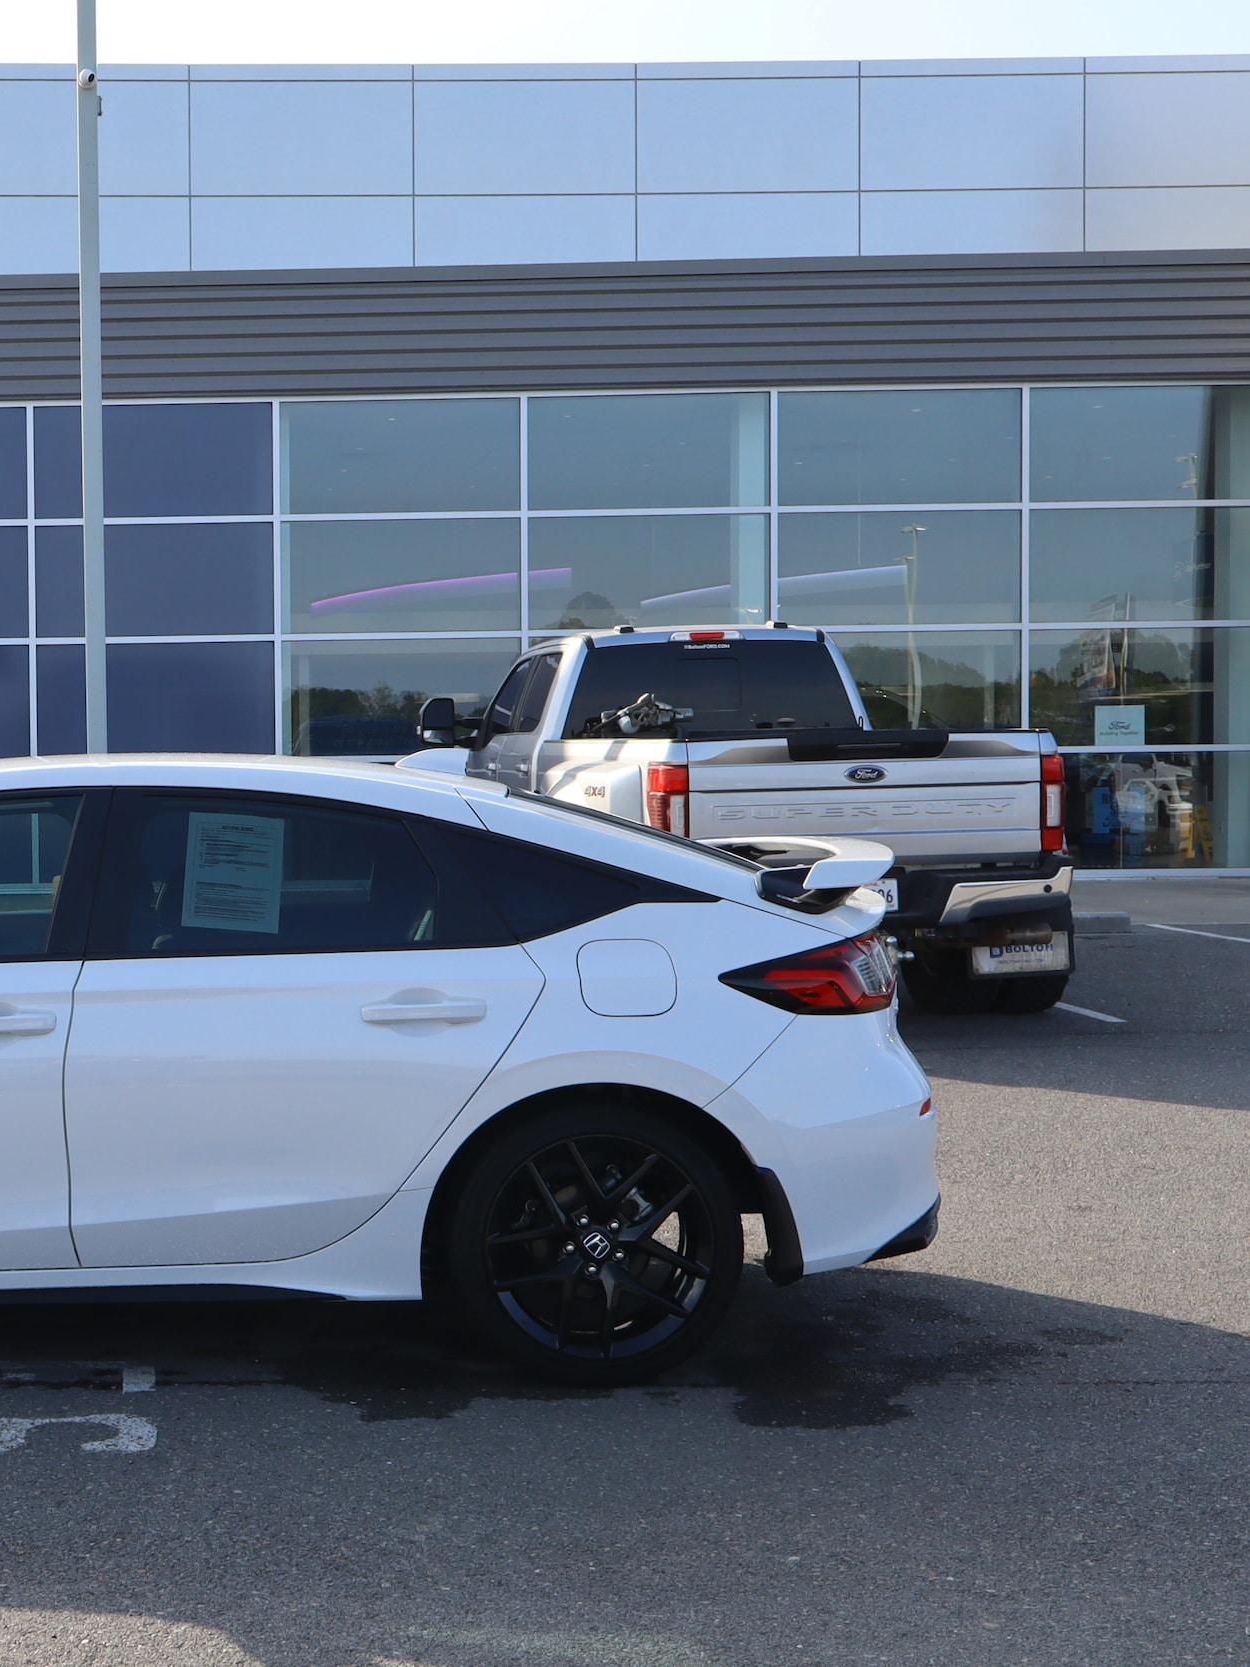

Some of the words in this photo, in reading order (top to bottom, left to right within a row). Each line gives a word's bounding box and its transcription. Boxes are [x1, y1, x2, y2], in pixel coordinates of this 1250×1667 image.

[1108, 721, 1130, 730] Ford
[717, 805, 878, 821] SUPER
[891, 801, 1013, 817] DUTY
[1005, 944, 1053, 953] BOLTON
